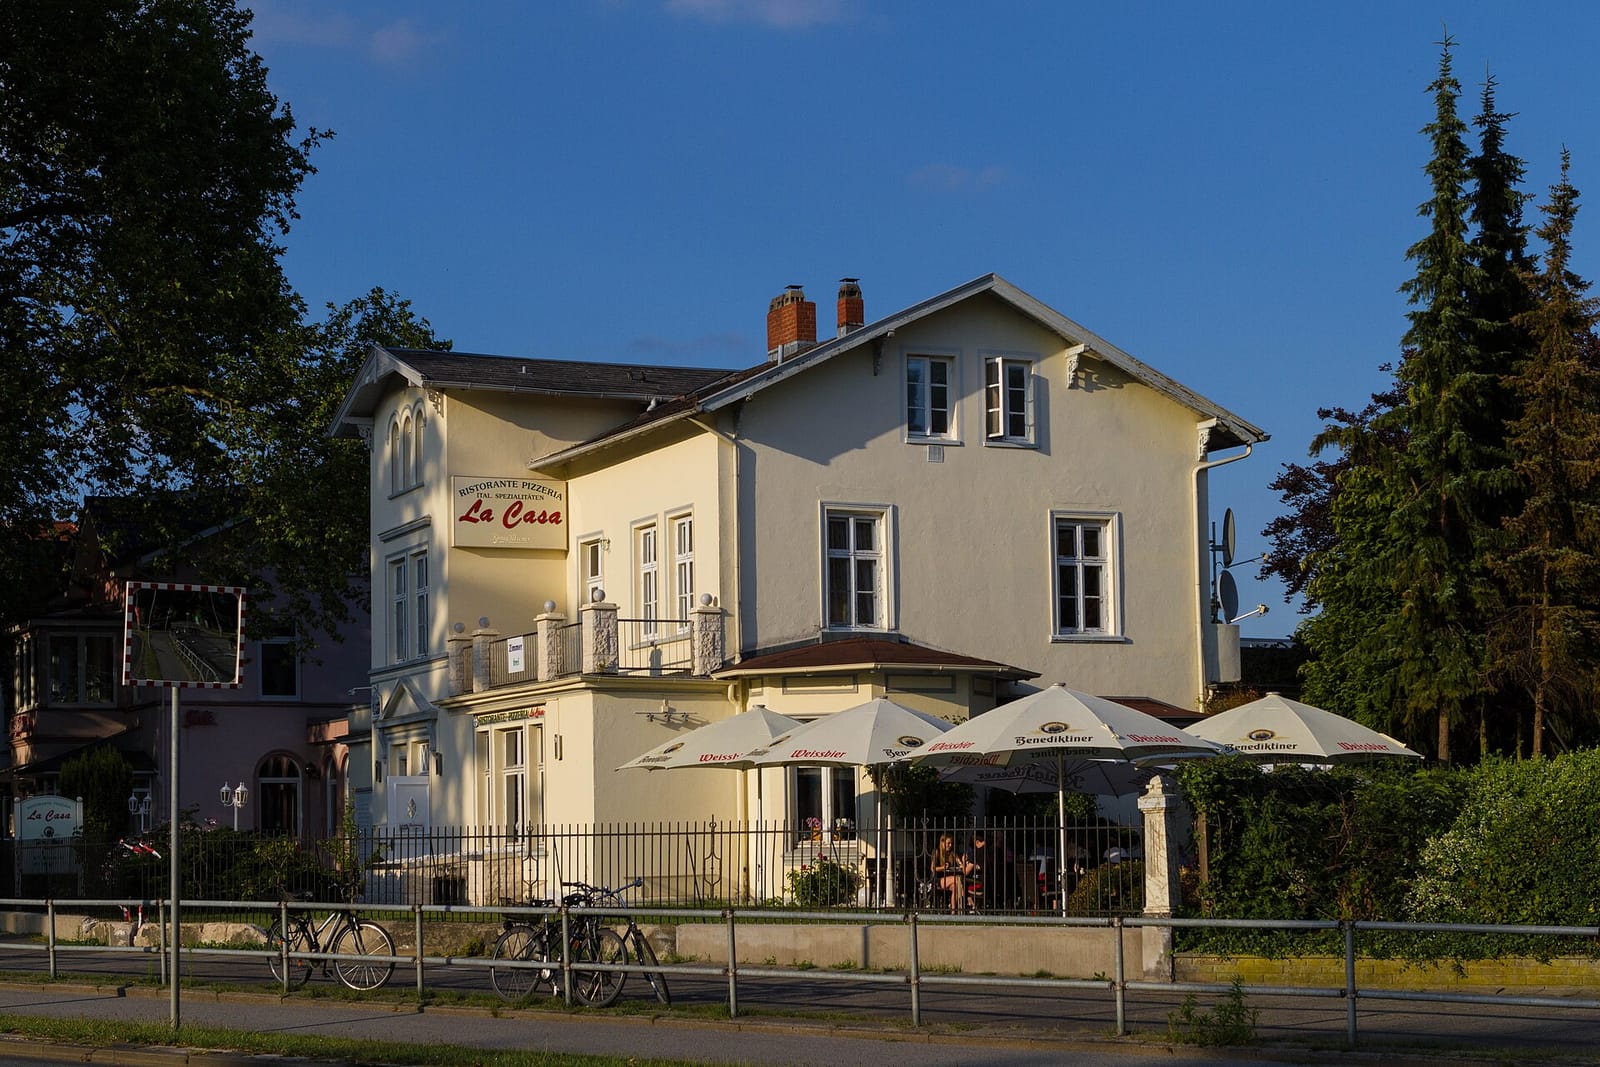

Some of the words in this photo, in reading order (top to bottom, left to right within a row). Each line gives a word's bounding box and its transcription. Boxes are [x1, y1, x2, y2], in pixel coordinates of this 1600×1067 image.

[458, 480, 519, 497] RISTORANTE
[521, 481, 563, 501] PIZZERIA
[495, 493, 545, 501] SPEZIALITÄTEN
[458, 499, 495, 524] La
[502, 500, 563, 529] Casa
[1015, 735, 1094, 746] Benediktiner
[1336, 741, 1392, 751] Weissbier
[1224, 742, 1298, 753] Benediktiner
[790, 749, 847, 759] Weissbier
[27, 810, 42, 820] La
[45, 810, 71, 821] Casa
